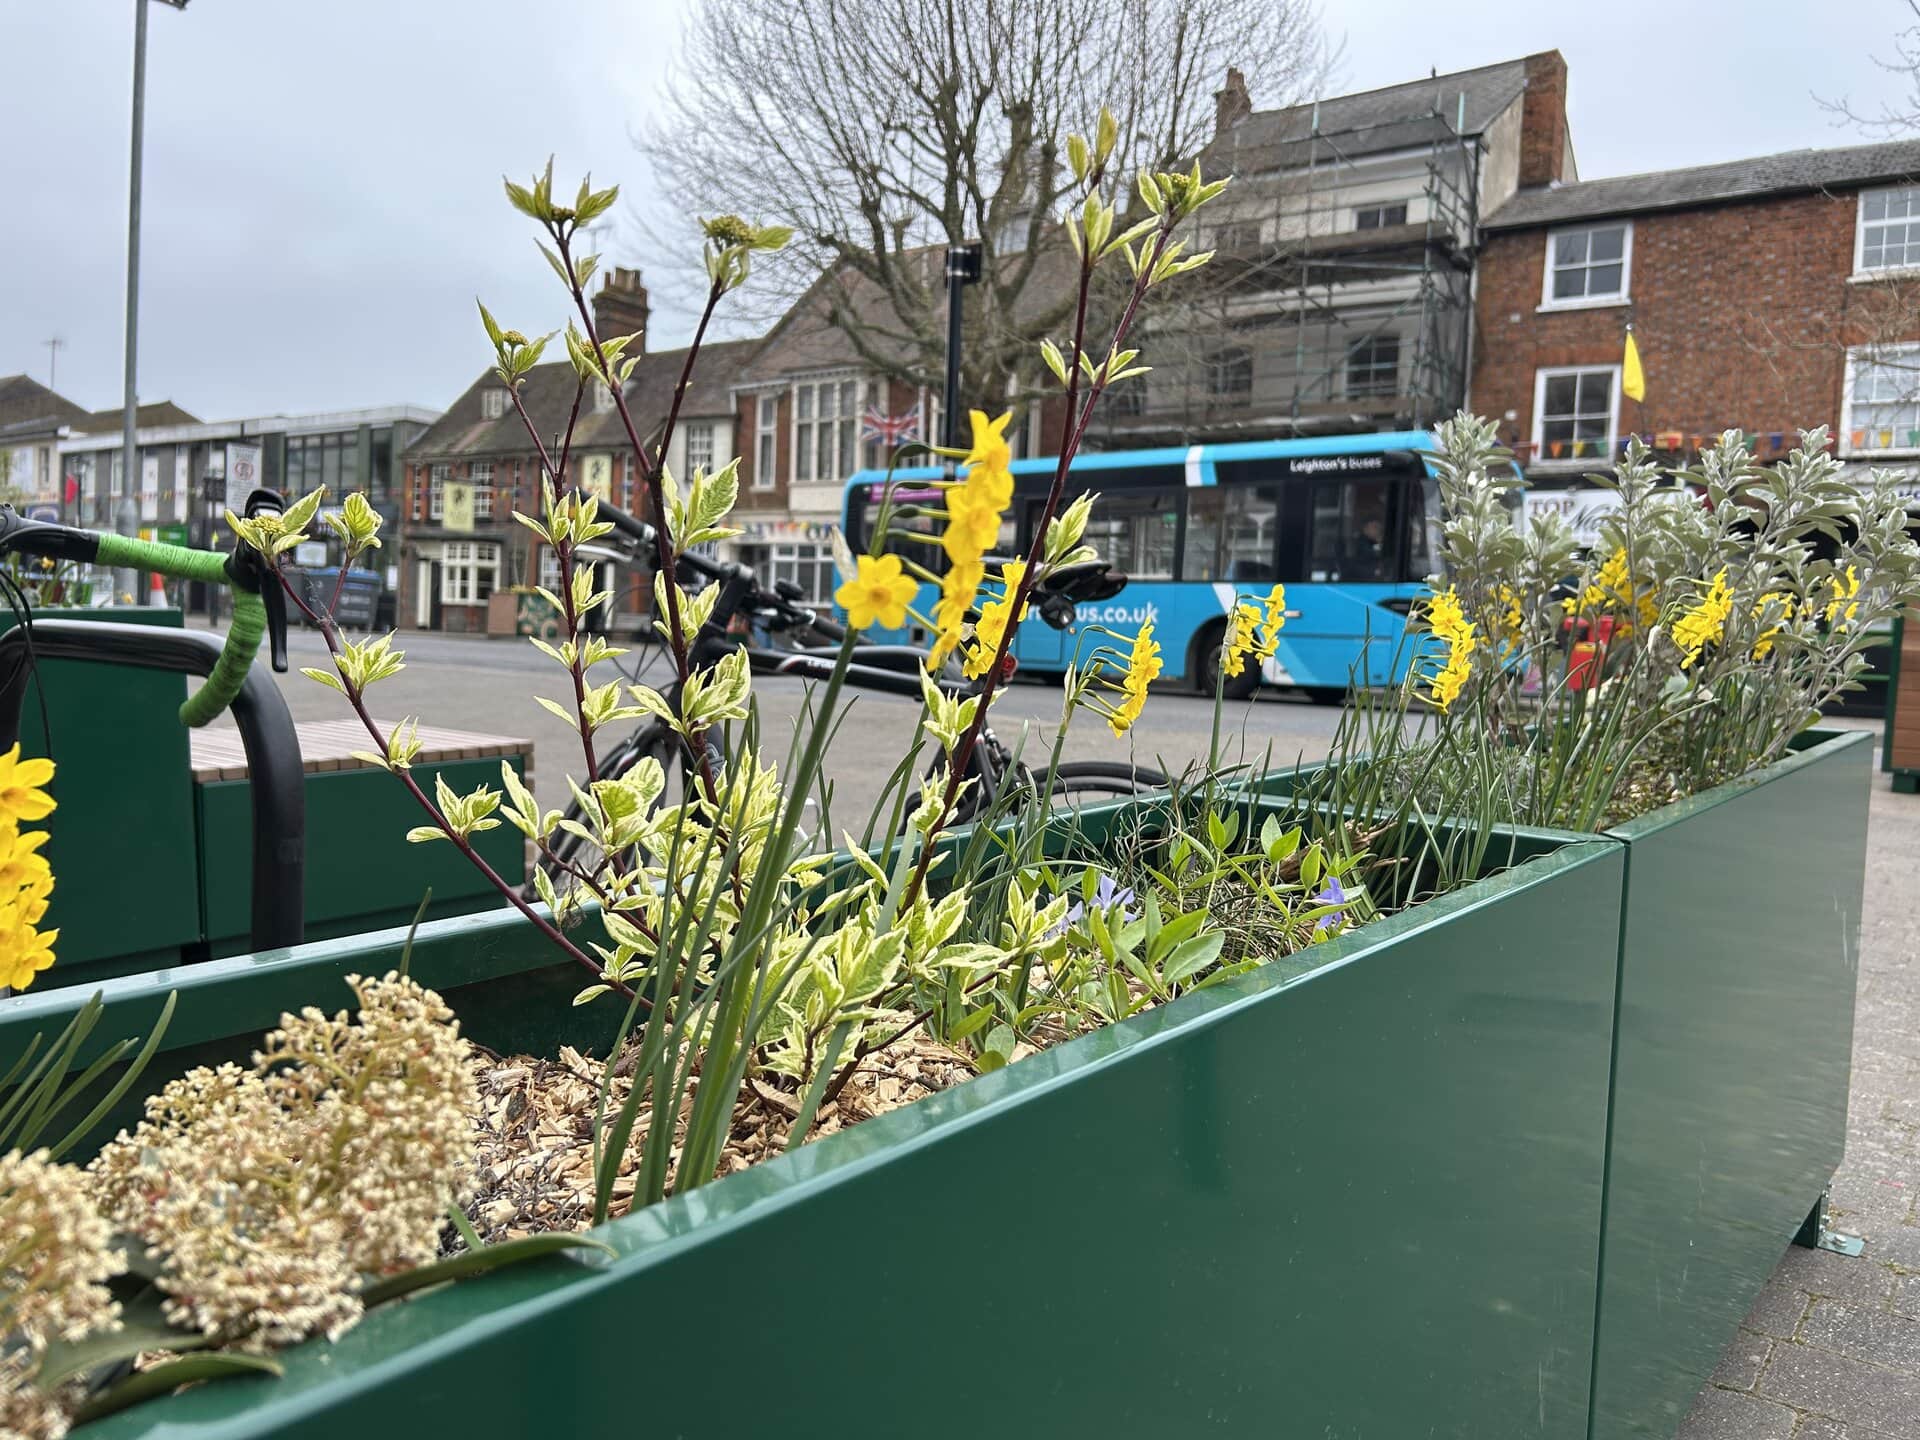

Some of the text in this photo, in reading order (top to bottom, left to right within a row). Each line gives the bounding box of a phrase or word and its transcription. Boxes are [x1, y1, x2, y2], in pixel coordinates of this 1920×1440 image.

[1289, 455, 1383, 474] Leighton's buses
[1529, 500, 1574, 515] TOP
